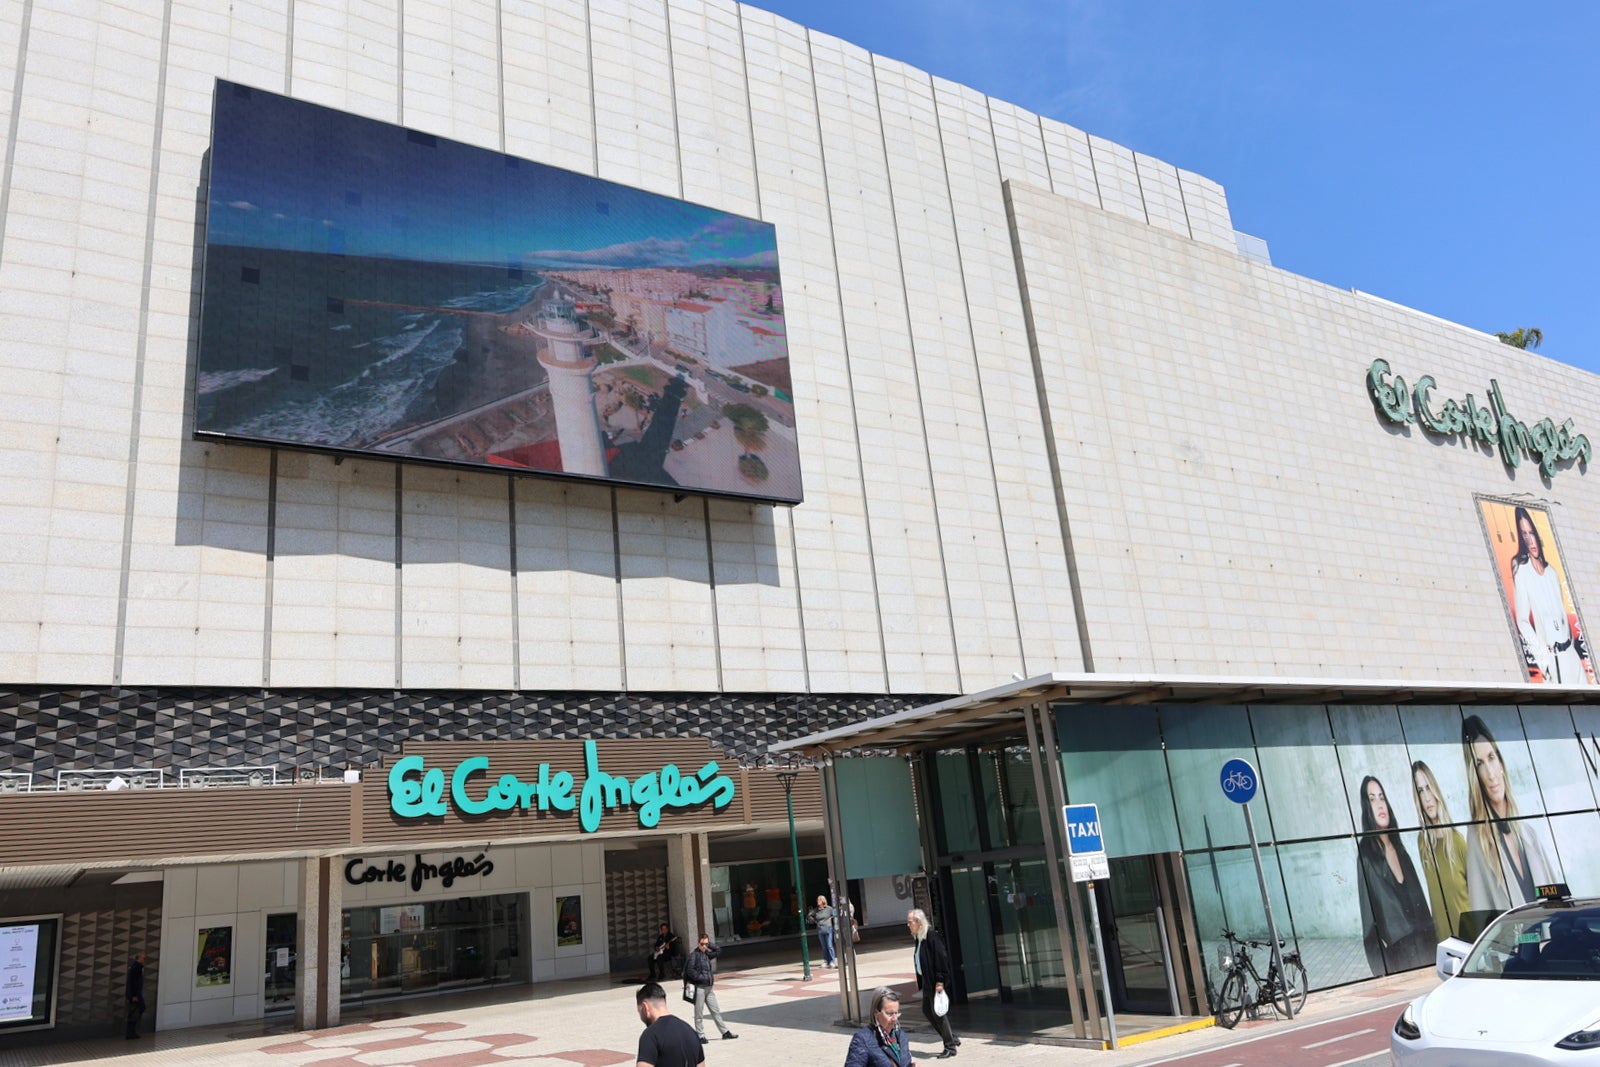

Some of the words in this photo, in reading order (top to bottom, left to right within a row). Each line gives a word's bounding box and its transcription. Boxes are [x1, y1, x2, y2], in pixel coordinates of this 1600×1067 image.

[1366, 358, 1417, 424] El
[1415, 374, 1498, 445] Corte
[1490, 378, 1593, 478] Inglés
[388, 755, 448, 818] El
[451, 756, 577, 815] Corte
[579, 740, 735, 833] Inglés
[1068, 821, 1100, 838] TAXI
[344, 858, 406, 886] Corte
[411, 853, 494, 892] Inglés
[1540, 886, 1557, 895] TAXI
